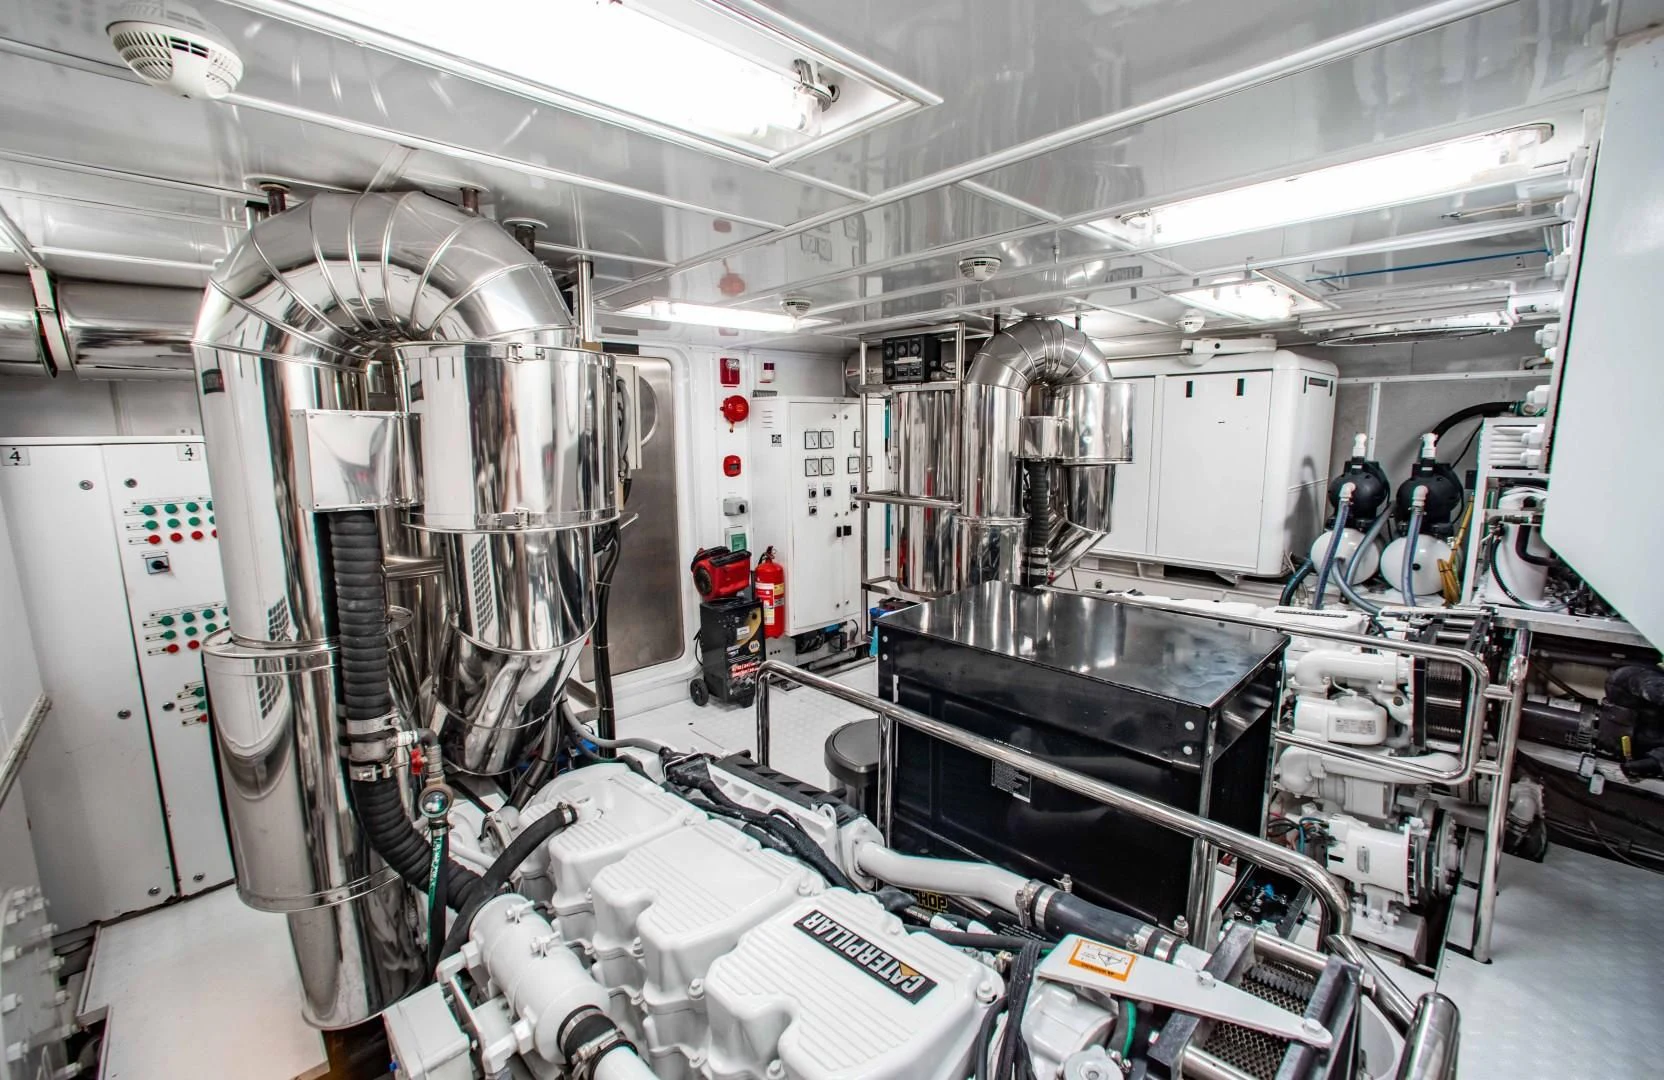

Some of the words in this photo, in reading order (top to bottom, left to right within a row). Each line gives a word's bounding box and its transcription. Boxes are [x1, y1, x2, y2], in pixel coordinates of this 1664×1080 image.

[9, 451, 21, 462] 4
[184, 447, 194, 458] 4
[802, 912, 927, 994] CATERPILLAR
